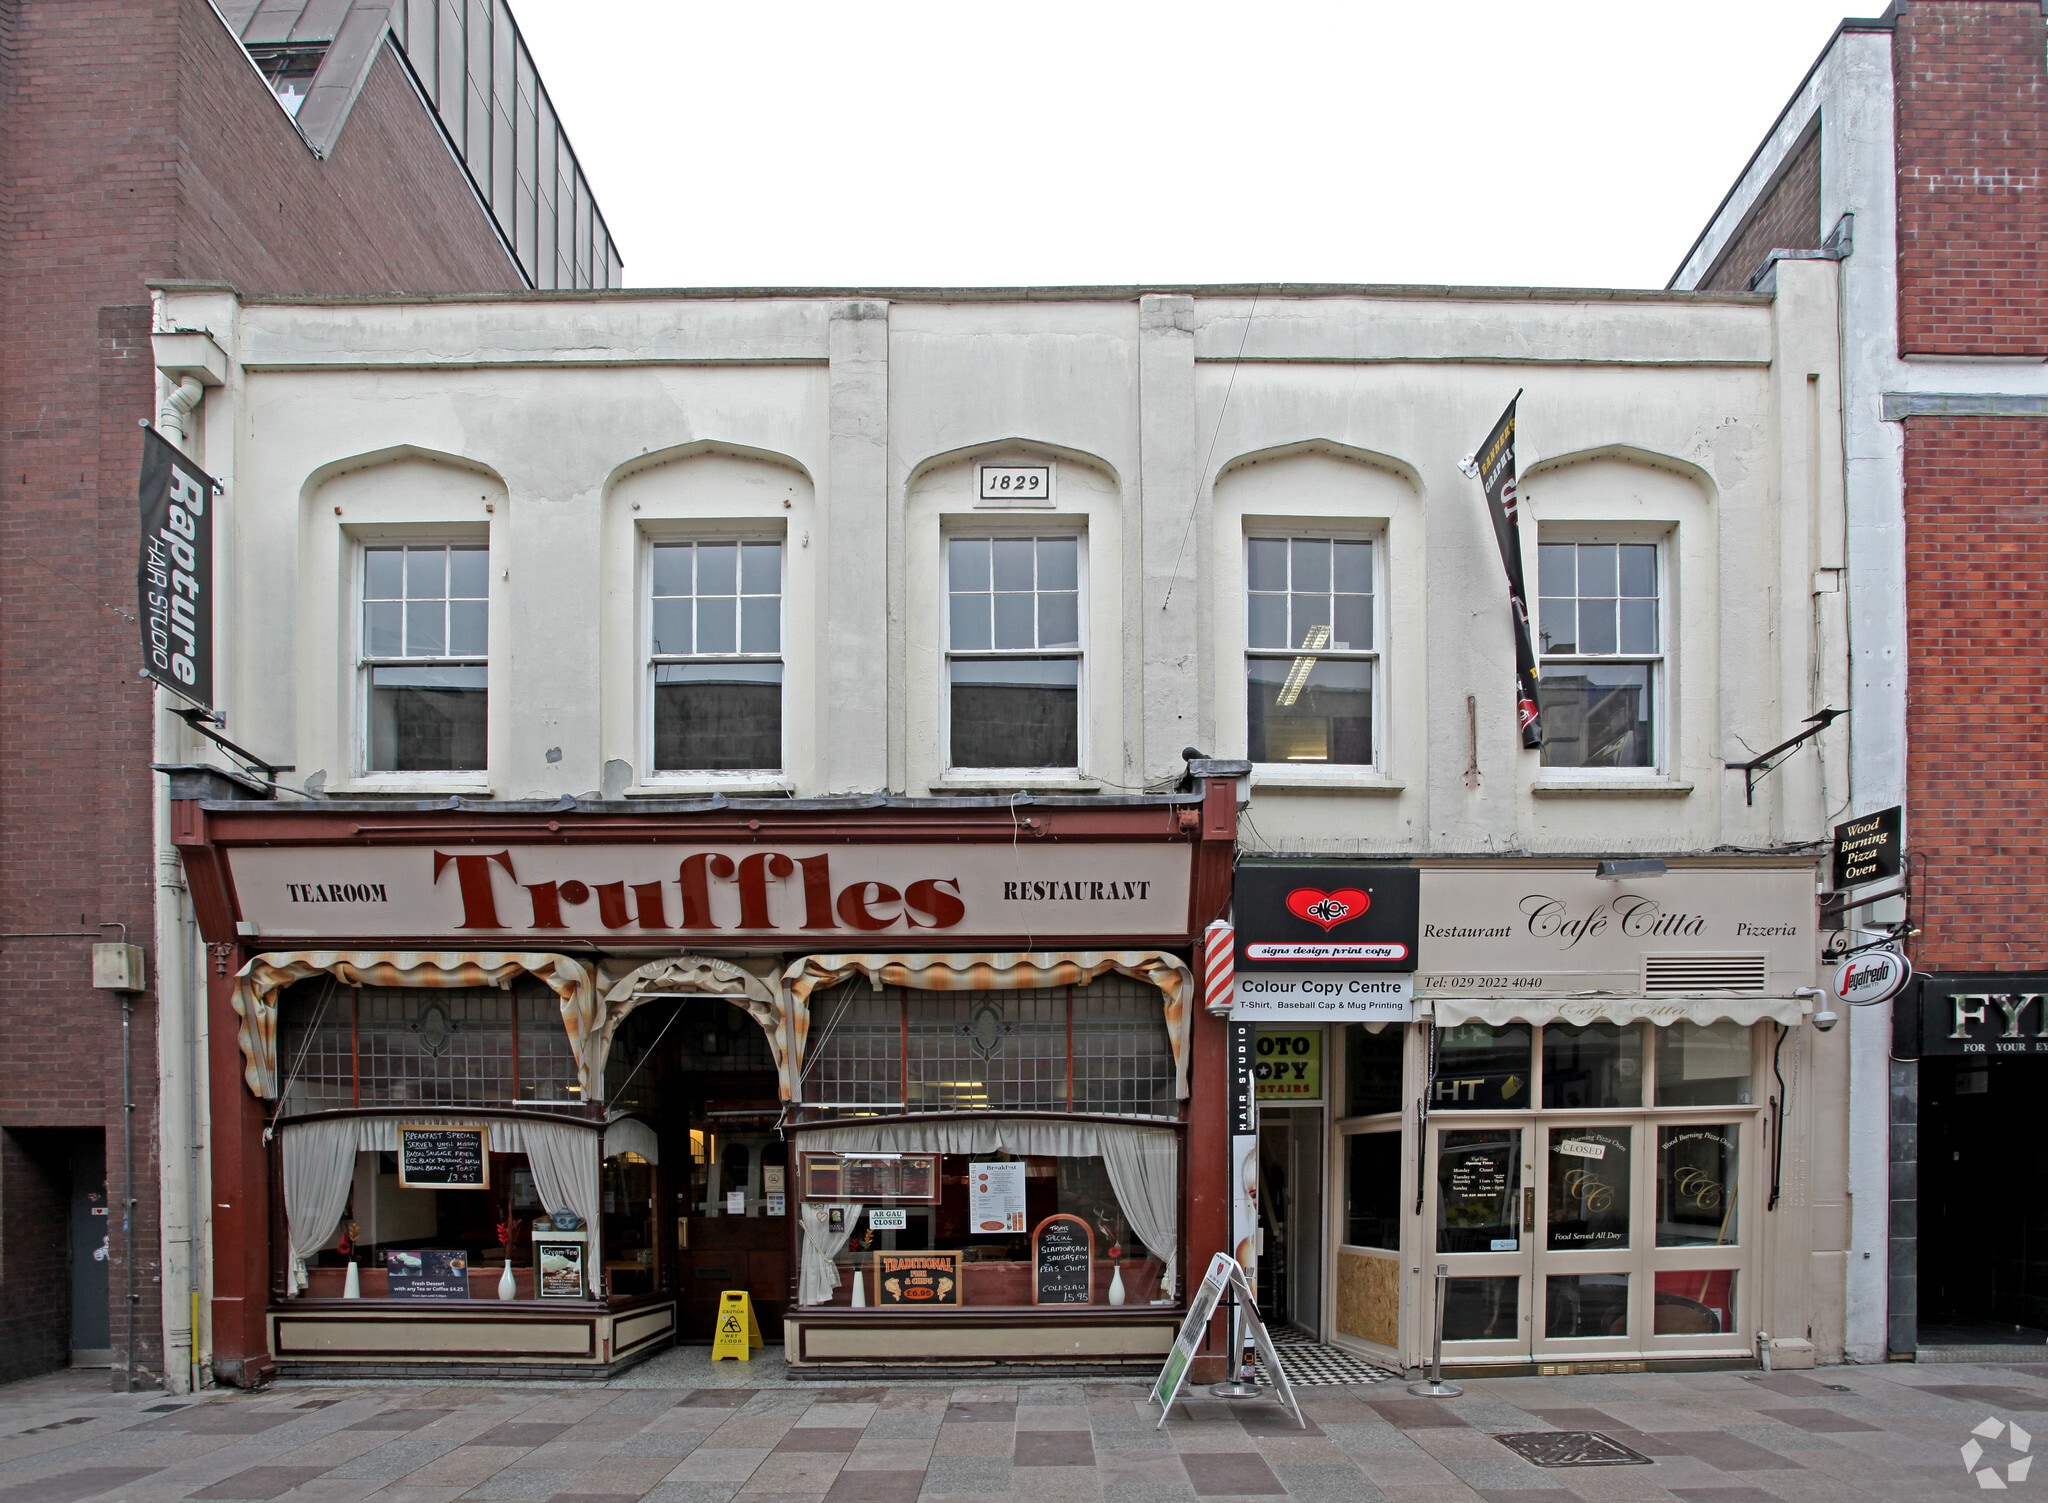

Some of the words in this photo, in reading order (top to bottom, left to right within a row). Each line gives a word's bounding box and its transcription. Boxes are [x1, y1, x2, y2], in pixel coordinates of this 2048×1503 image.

[989, 475, 1039, 491] 1829
[147, 534, 168, 590] HAIR
[161, 463, 204, 686] Rapture
[148, 590, 169, 671] STUDIO
[1846, 816, 1881, 837] Wood
[1840, 830, 1889, 854] Burning
[1846, 847, 1878, 866] Pizza
[1845, 862, 1878, 880] Oven
[286, 883, 388, 903] TEAROOM
[433, 849, 965, 931] Truffles
[1003, 880, 1151, 901] RESTAURANT
[1423, 923, 1512, 938] Restaurant
[1518, 894, 1608, 951] Café
[1735, 922, 1797, 937] Pizzeria
[1261, 946, 1290, 957] signs
[1293, 946, 1330, 957] design
[1332, 946, 1363, 957] print
[1365, 947, 1392, 957] copy
[1424, 976, 1448, 988] Tel:
[1451, 977, 1475, 988] 029
[1477, 977, 1508, 988] 2022
[1511, 977, 1543, 988] 4040
[1839, 960, 1890, 997] Segafredo
[1242, 980, 1297, 993] Colour
[1301, 980, 1344, 996] Copy
[1348, 980, 1402, 993] Centre
[1277, 1001, 1316, 1010] Baseball
[1318, 1001, 1336, 1010] Cap
[1338, 1001, 1345, 1009] &
[1347, 1001, 1367, 1011] Mug
[1369, 1001, 1404, 1011] Printing
[1238, 1027, 1246, 1084] STUDIO
[1256, 1037, 1310, 1056] OTO
[1963, 1043, 1986, 1052] FOR
[1996, 1043, 2026, 1052] YOUR
[1256, 1062, 1308, 1080] OPY
[1256, 1084, 1310, 1093] STAIRS
[1239, 1095, 1247, 1131] HAIR
[446, 1131, 477, 1140] SPECIAL
[1661, 1137, 1678, 1150] Wood
[1679, 1131, 1703, 1141] Burning
[1563, 1143, 1603, 1156] CLOSED
[873, 1218, 903, 1226] CLOSED
[1554, 1232, 1571, 1240] Food
[1572, 1231, 1595, 1240] Served
[1596, 1231, 1606, 1239] All
[1607, 1231, 1622, 1240] Day
[883, 1257, 954, 1273] TRADITIONAL
[1064, 1264, 1087, 1272] CHIPS
